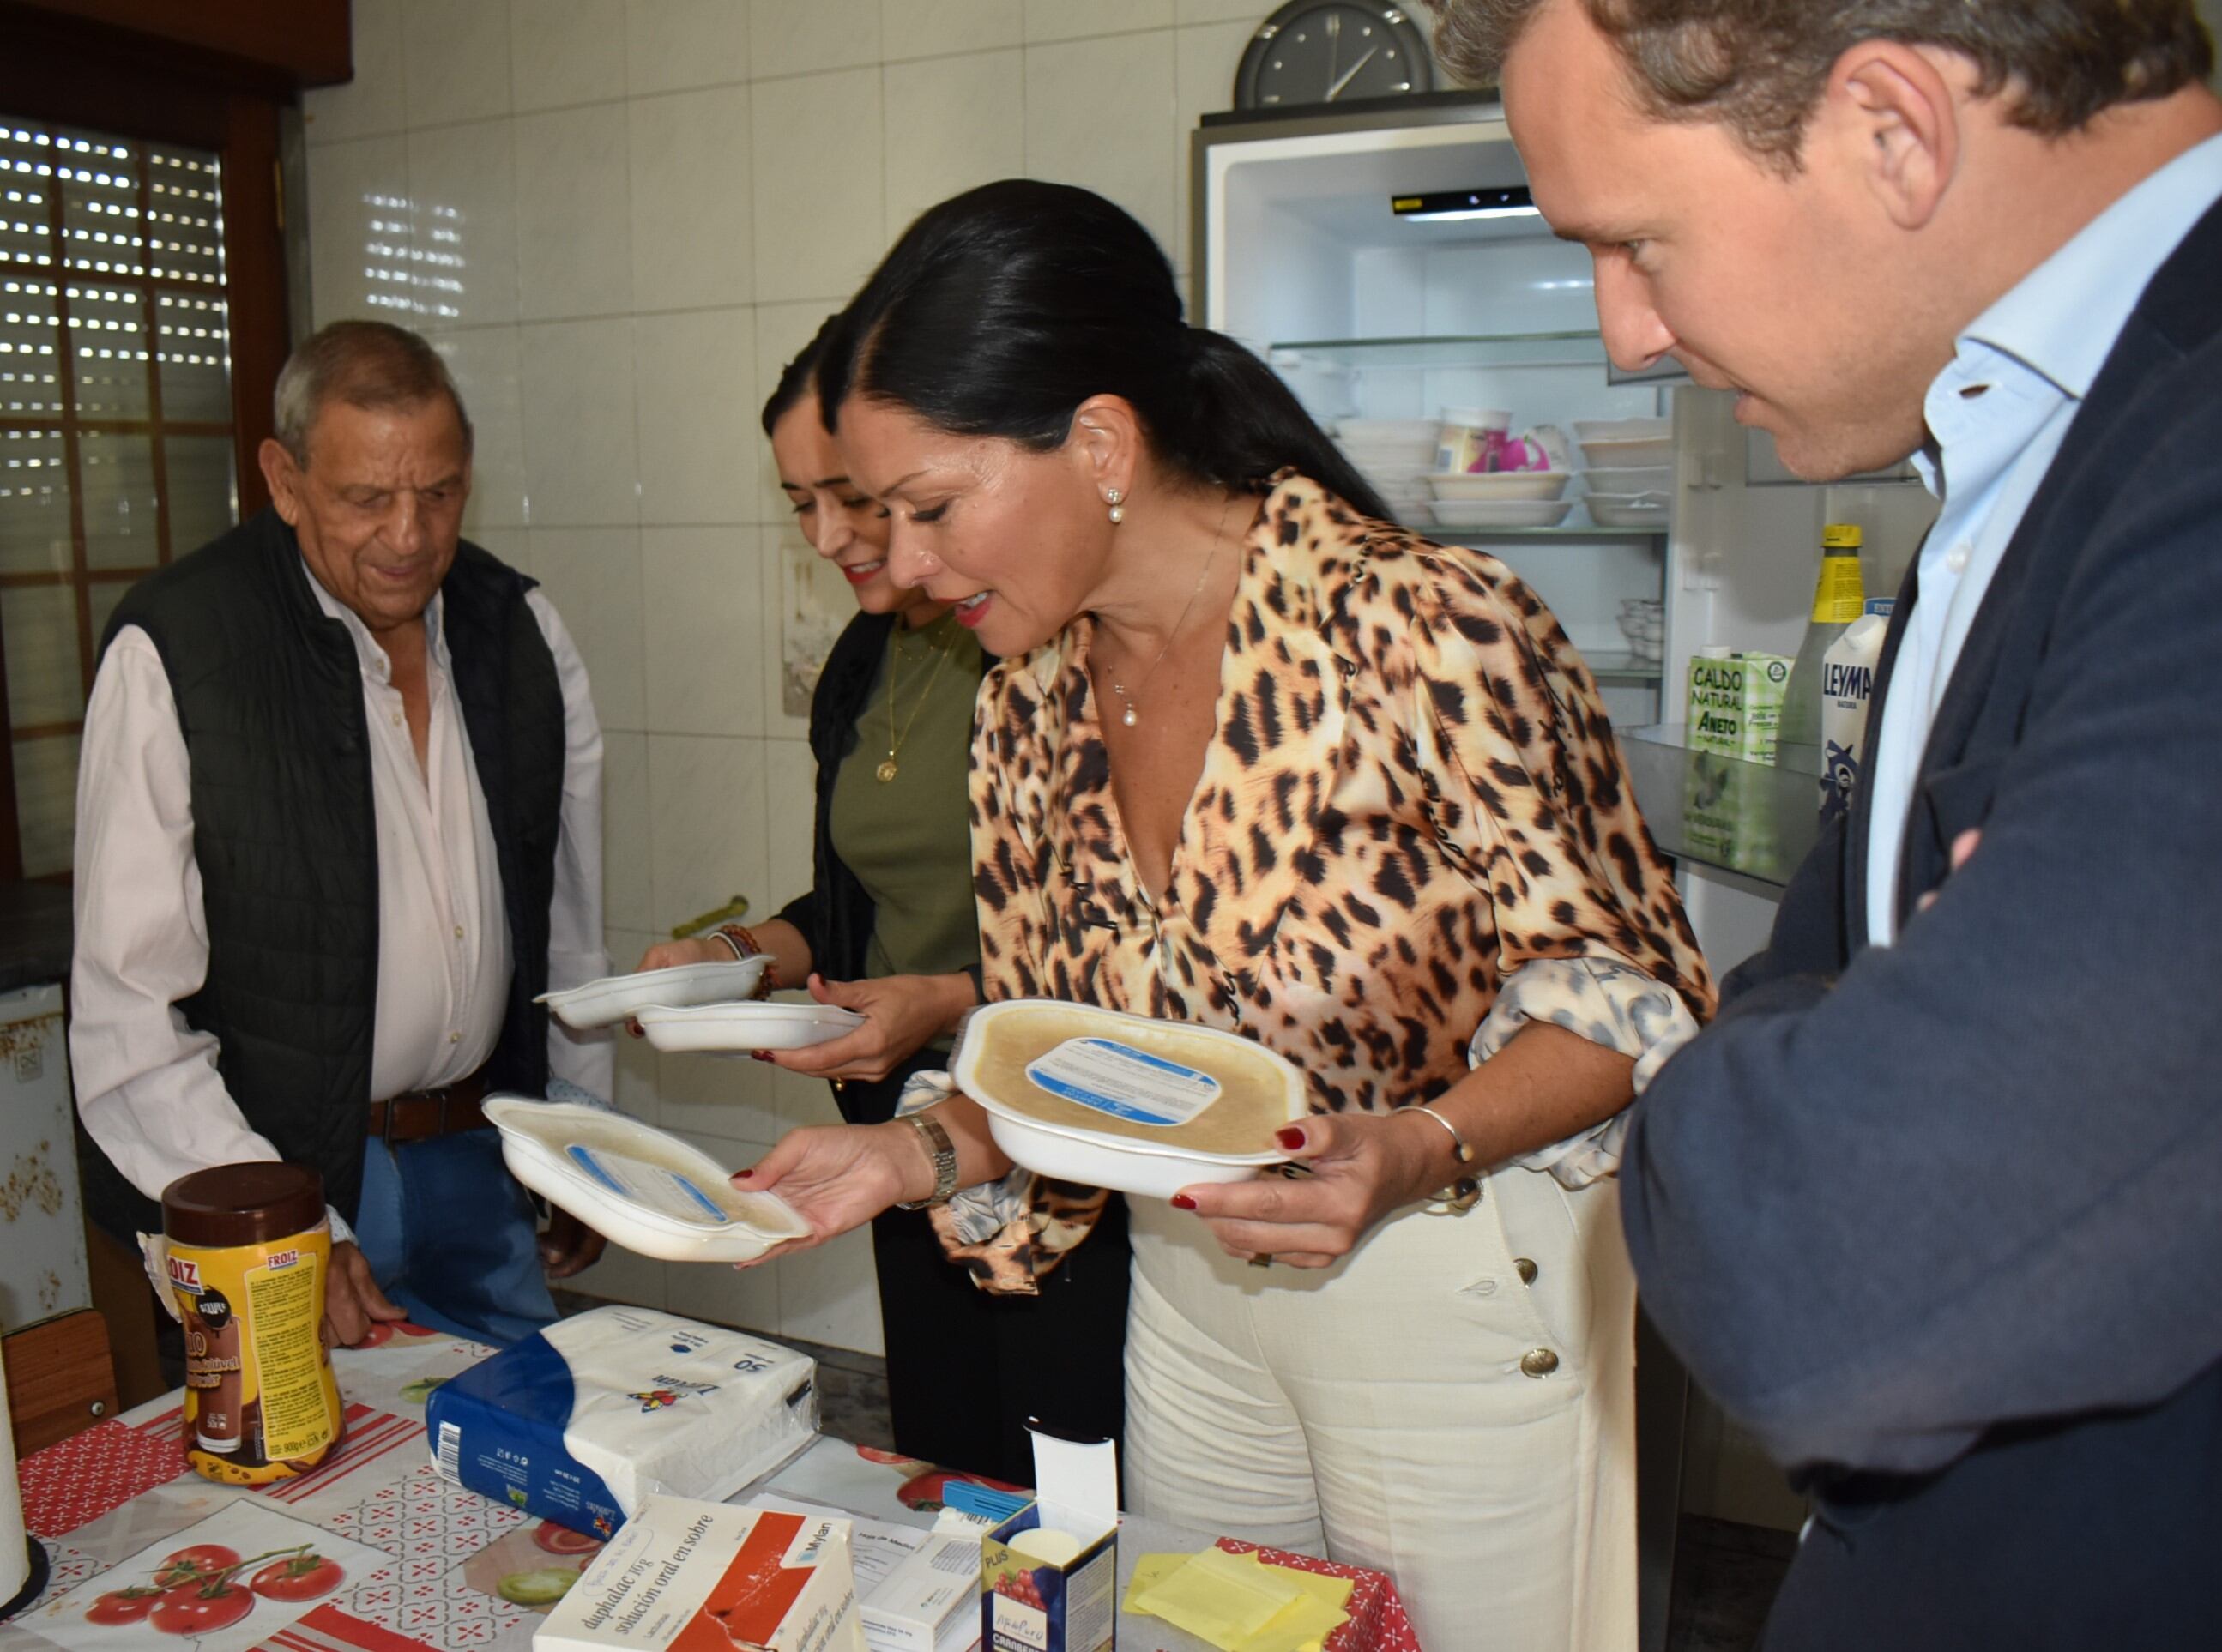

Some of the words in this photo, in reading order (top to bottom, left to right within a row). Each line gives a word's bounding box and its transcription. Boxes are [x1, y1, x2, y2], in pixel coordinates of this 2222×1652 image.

[1694, 667, 1742, 691] CALDO
[1823, 663, 1873, 700] LEYMA
[1691, 690, 1742, 711] NATURAL
[267, 1251, 298, 1268] FROIZ
[805, 1522, 832, 1551] Mylan
[985, 1550, 1009, 1568] PLUS
[615, 1586, 661, 1635] solución
[654, 1560, 680, 1587] oral
[673, 1545, 692, 1562] en
[683, 1514, 714, 1546] sobre
[581, 1575, 636, 1631] duphalac
[628, 1562, 644, 1577] 10
[640, 1558, 654, 1568] g
